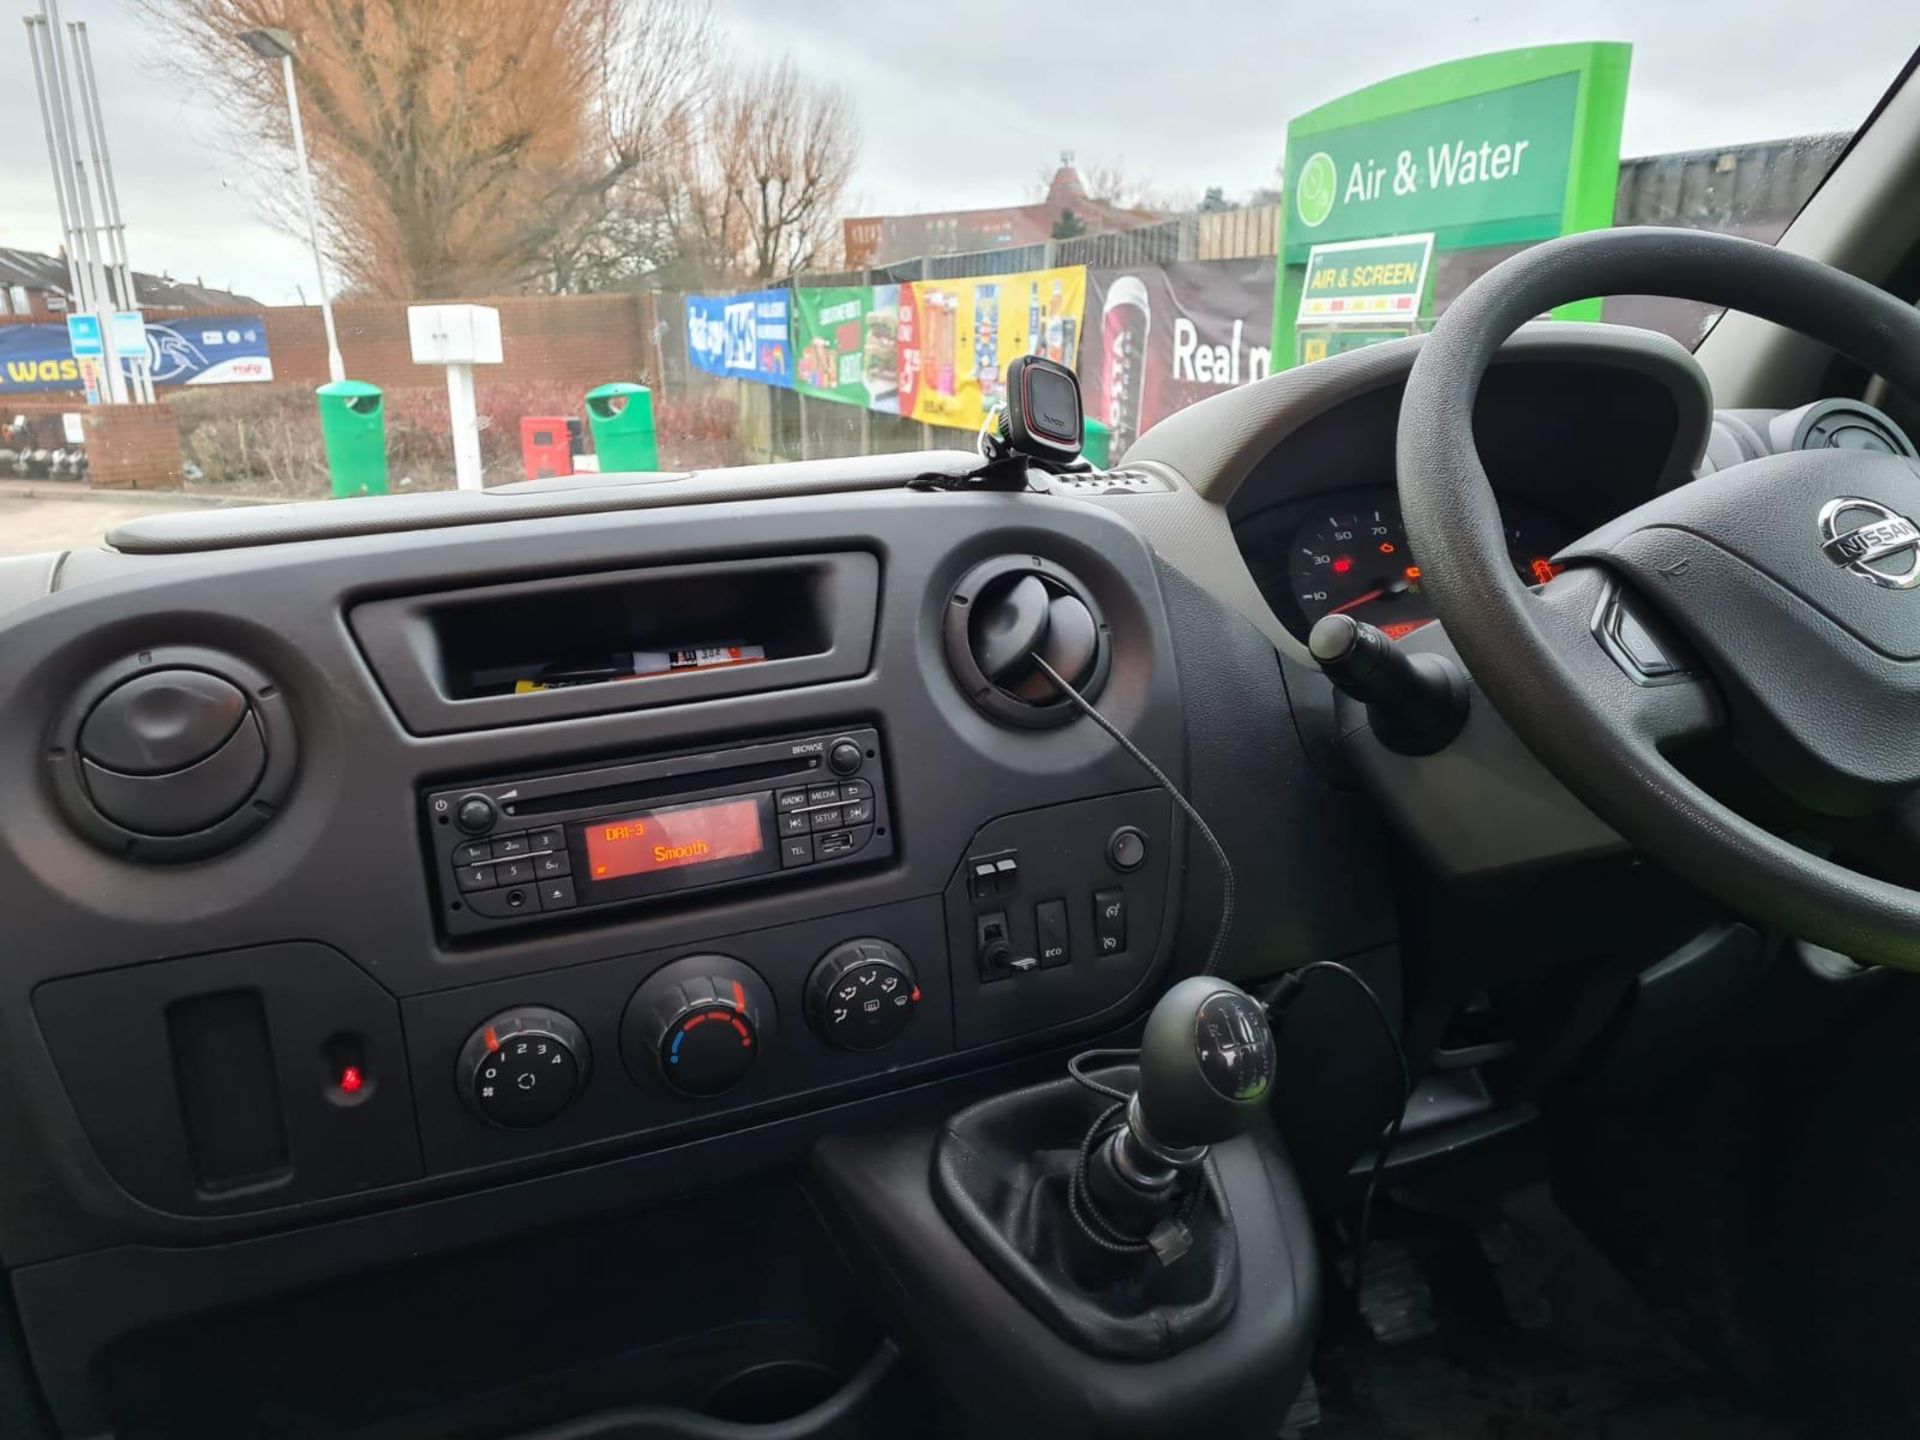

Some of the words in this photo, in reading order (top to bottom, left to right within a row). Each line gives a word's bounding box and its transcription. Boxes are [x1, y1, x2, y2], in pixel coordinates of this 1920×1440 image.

[1343, 159, 1387, 204] Air
[1393, 150, 1417, 196] &
[1427, 139, 1529, 190] Water
[1311, 269, 1336, 289] AIR
[1337, 268, 1349, 288] &
[1351, 262, 1417, 288] SCREEN
[1172, 317, 1243, 385] Real
[6, 358, 92, 384] was
[1335, 531, 1352, 541] 50
[1371, 526, 1387, 536] 70
[1837, 521, 1917, 558] NISSAN
[1314, 555, 1330, 565] 30
[1313, 591, 1327, 600] 10
[792, 742, 824, 755] BROWSE
[781, 795, 804, 806] RADIO
[811, 789, 836, 801] MEDIA
[815, 811, 837, 823] SETUP
[654, 840, 707, 862] Smooth
[791, 846, 805, 856] TEL
[511, 866, 517, 876] 5
[1045, 947, 1062, 957] ECO
[517, 1043, 528, 1054] 2
[537, 1044, 547, 1055] 3
[551, 1054, 561, 1064] 4
